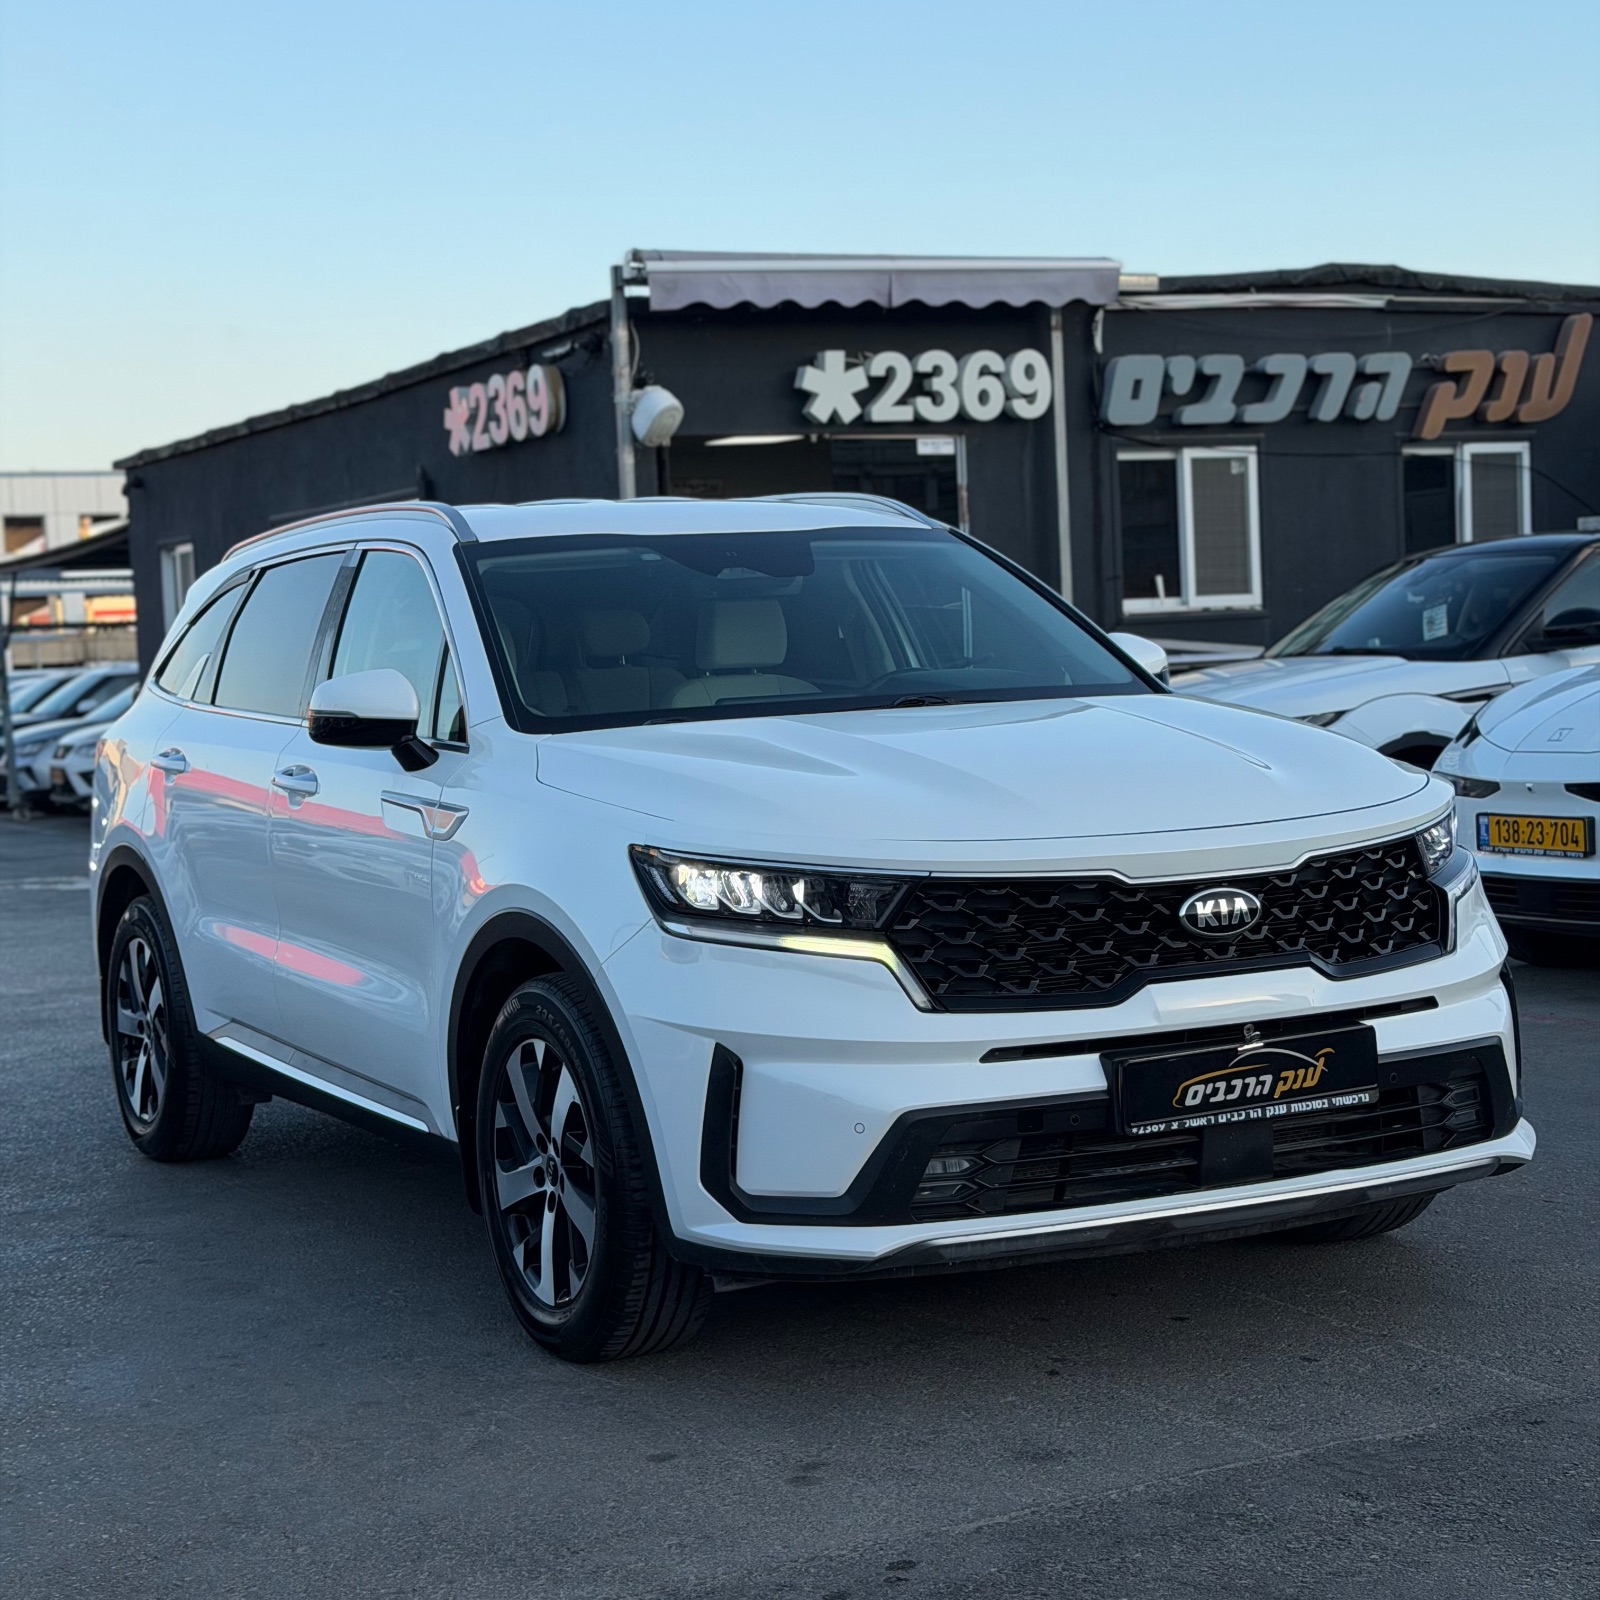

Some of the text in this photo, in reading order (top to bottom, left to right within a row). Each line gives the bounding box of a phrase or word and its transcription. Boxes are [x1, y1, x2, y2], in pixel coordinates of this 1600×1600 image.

[1105, 313, 1592, 439] ענק הרכבים
[1194, 897, 1252, 928] KIA
[1184, 1057, 1326, 1107] ענק הרכבים
[1290, 1099, 1329, 1113] בסוכנות
[1332, 1093, 1370, 1107] נרכשתי
[1218, 1107, 1262, 1123] הרכבים
[1265, 1103, 1288, 1117] ענק
